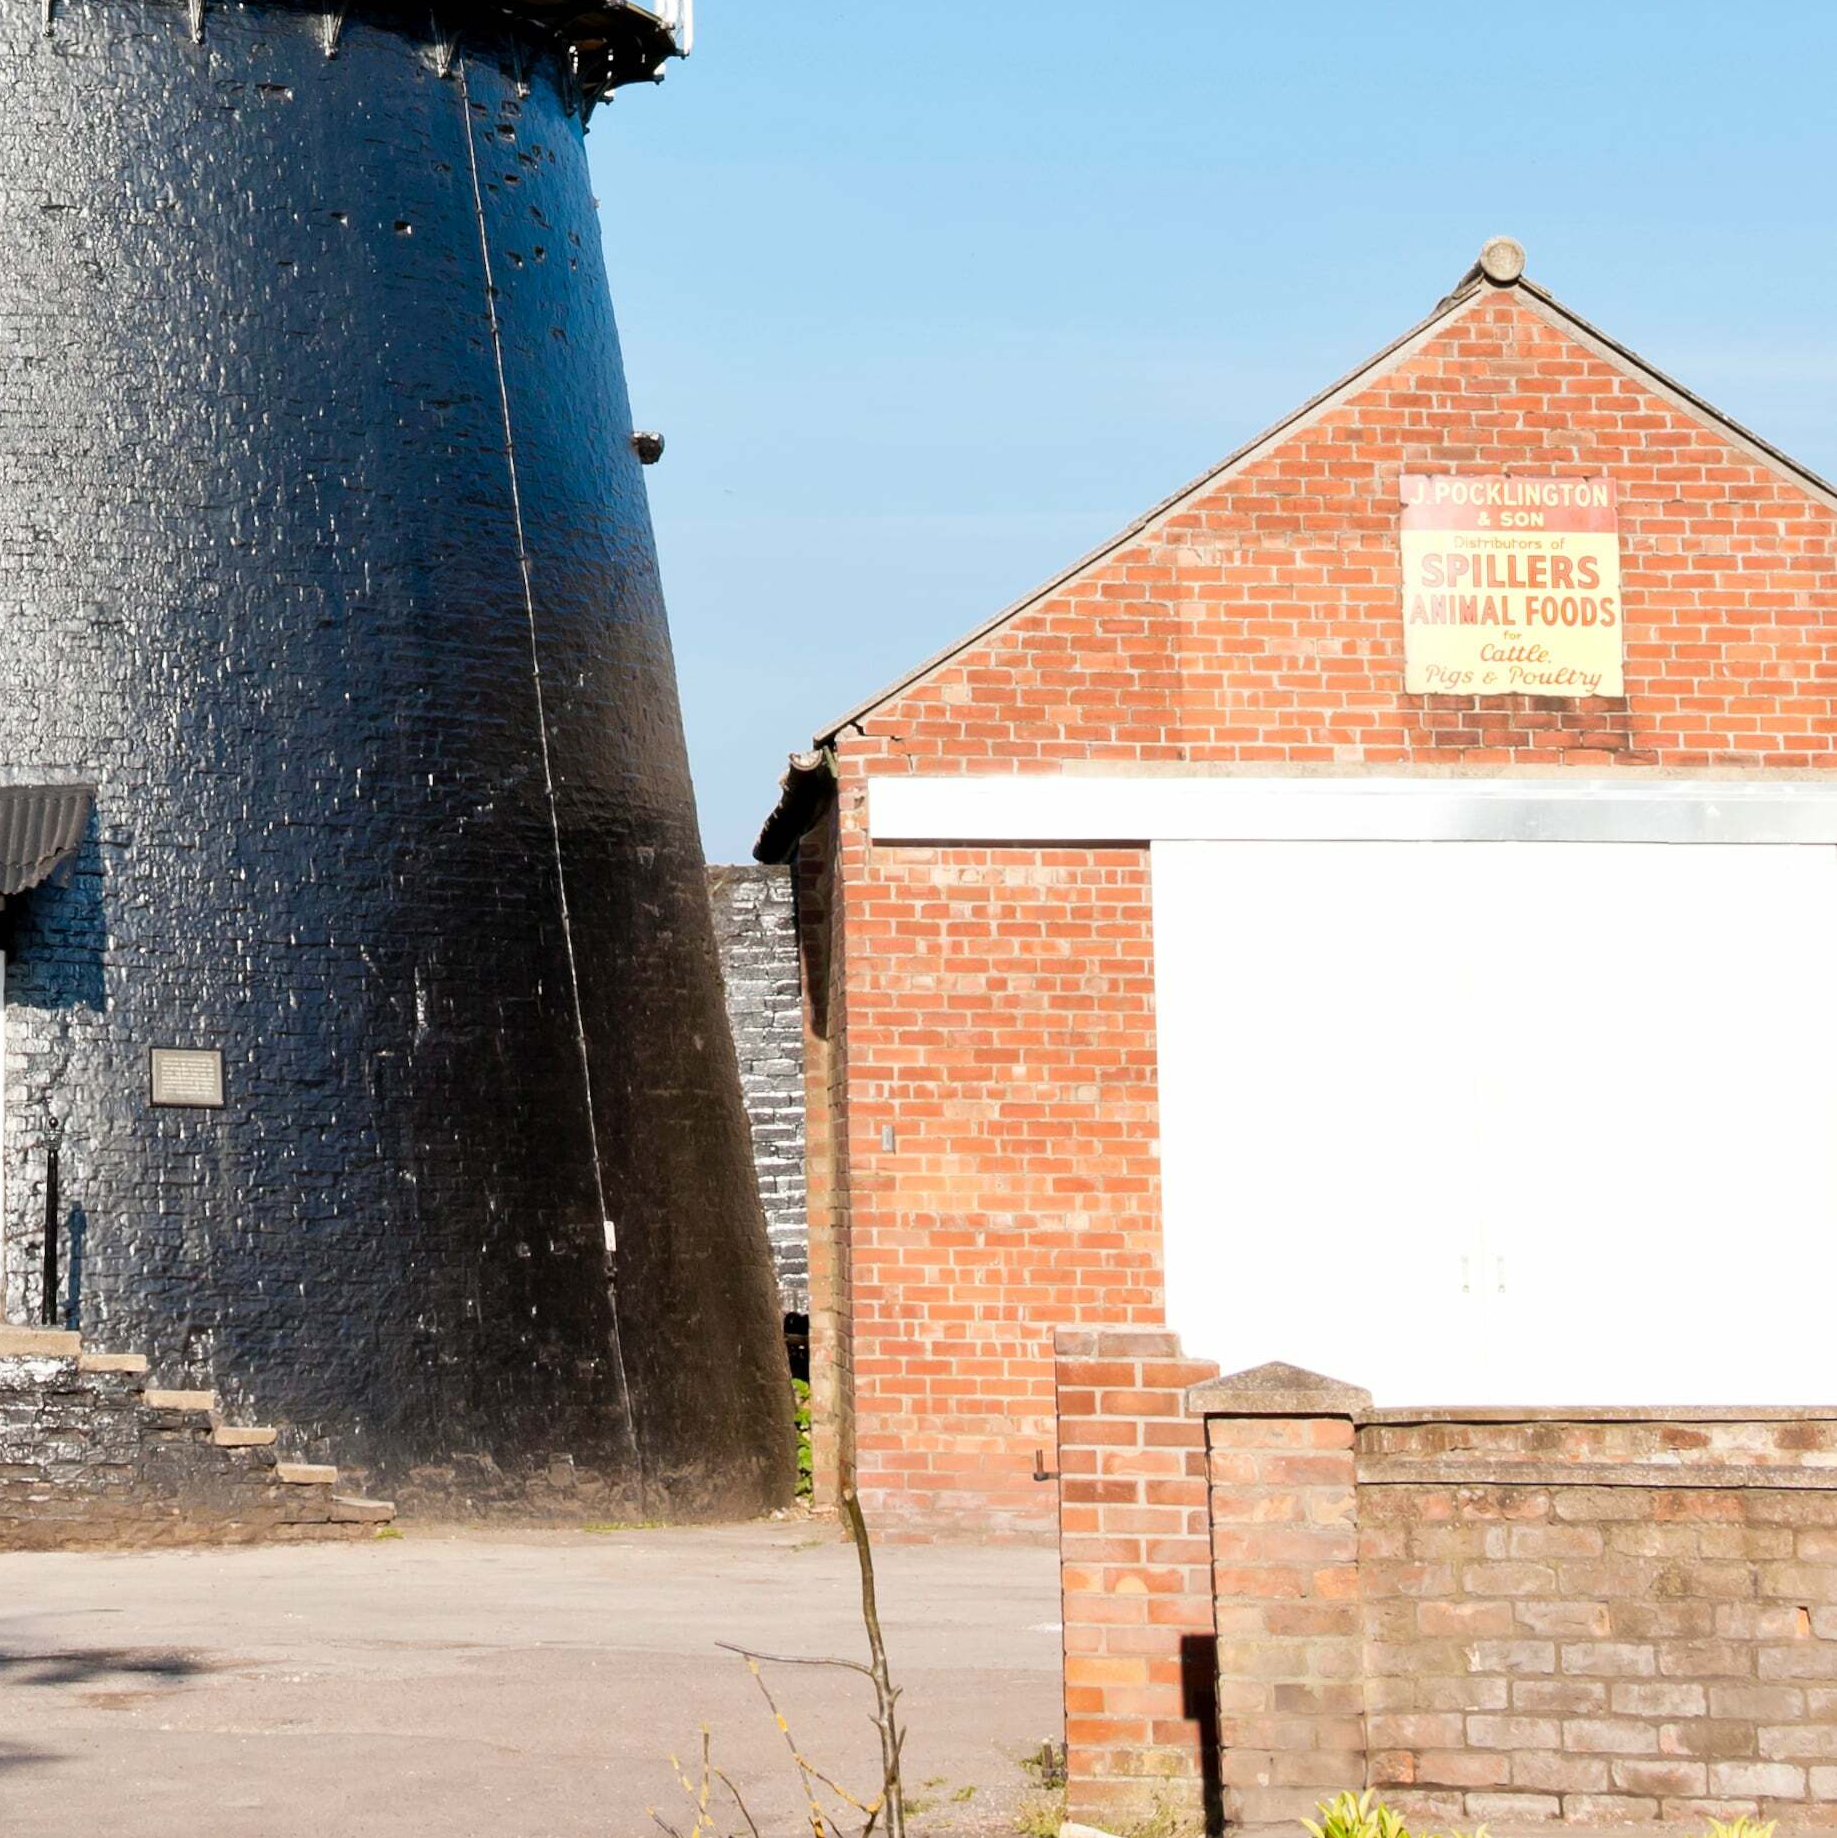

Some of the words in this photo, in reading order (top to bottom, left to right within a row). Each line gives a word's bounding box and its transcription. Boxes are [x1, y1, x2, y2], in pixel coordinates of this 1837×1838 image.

[1477, 512, 1491, 527] &
[1500, 512, 1544, 527] SON
[1454, 535, 1543, 550] Distributors
[1550, 536, 1566, 550] of
[1420, 554, 1600, 589] SPILLERS
[1409, 594, 1516, 626] ANIMAL
[1525, 595, 1616, 627] FOODS
[1503, 629, 1522, 640] for
[1425, 664, 1475, 689] Pigs
[1482, 673, 1498, 686] &
[1509, 665, 1603, 692] Poultry
